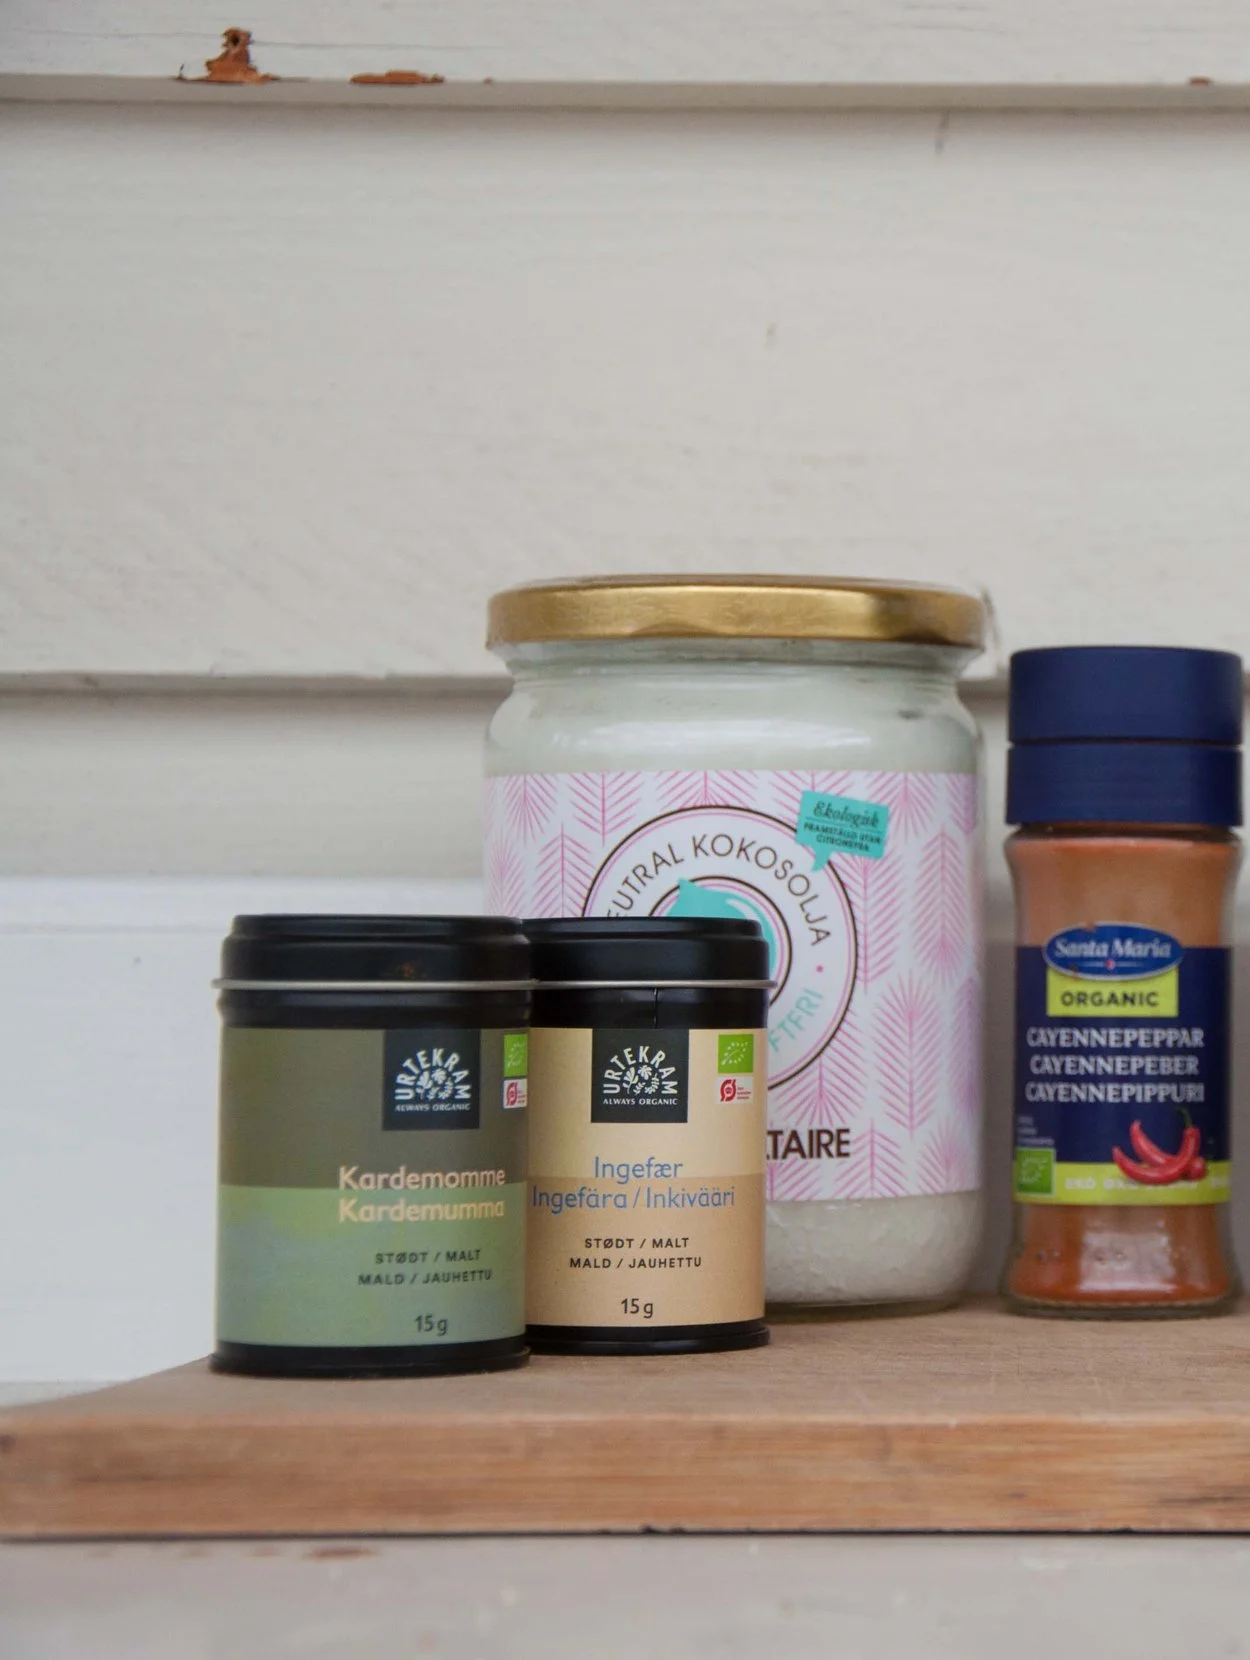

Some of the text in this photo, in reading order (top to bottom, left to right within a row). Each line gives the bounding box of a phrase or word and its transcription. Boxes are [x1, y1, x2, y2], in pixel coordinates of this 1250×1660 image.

[692, 834, 831, 946] KOKOSOLJA
[1055, 937, 1171, 959] Santa Maria
[1060, 991, 1160, 1008] ORGANIC
[1026, 1027, 1204, 1048] CAYENNEPEPPAR
[395, 1048, 471, 1100] URTEKRAM
[603, 1045, 678, 1094] URTEKRAM
[1030, 1055, 1199, 1076] CAYENNEPEBER
[1025, 1082, 1204, 1103] CAYENNEPIPPURI
[395, 1103, 471, 1112] ALWAYS ORGANIC
[766, 1128, 850, 1160] TAIRE
[339, 1165, 505, 1190] Kardemomme
[594, 1156, 684, 1184] Ingefær
[339, 1198, 504, 1223] Kardemumma
[532, 1186, 627, 1214] Ingefära
[646, 1186, 735, 1208] Inkivääri
[584, 1238, 634, 1249] STØDT
[652, 1237, 690, 1248] MALT
[375, 1253, 428, 1264] STØDT
[446, 1250, 480, 1262] MALT
[569, 1258, 611, 1269] MALD
[628, 1257, 702, 1269] JAUHETTU
[358, 1273, 404, 1285] MALD
[423, 1269, 492, 1284] JAUHETTU
